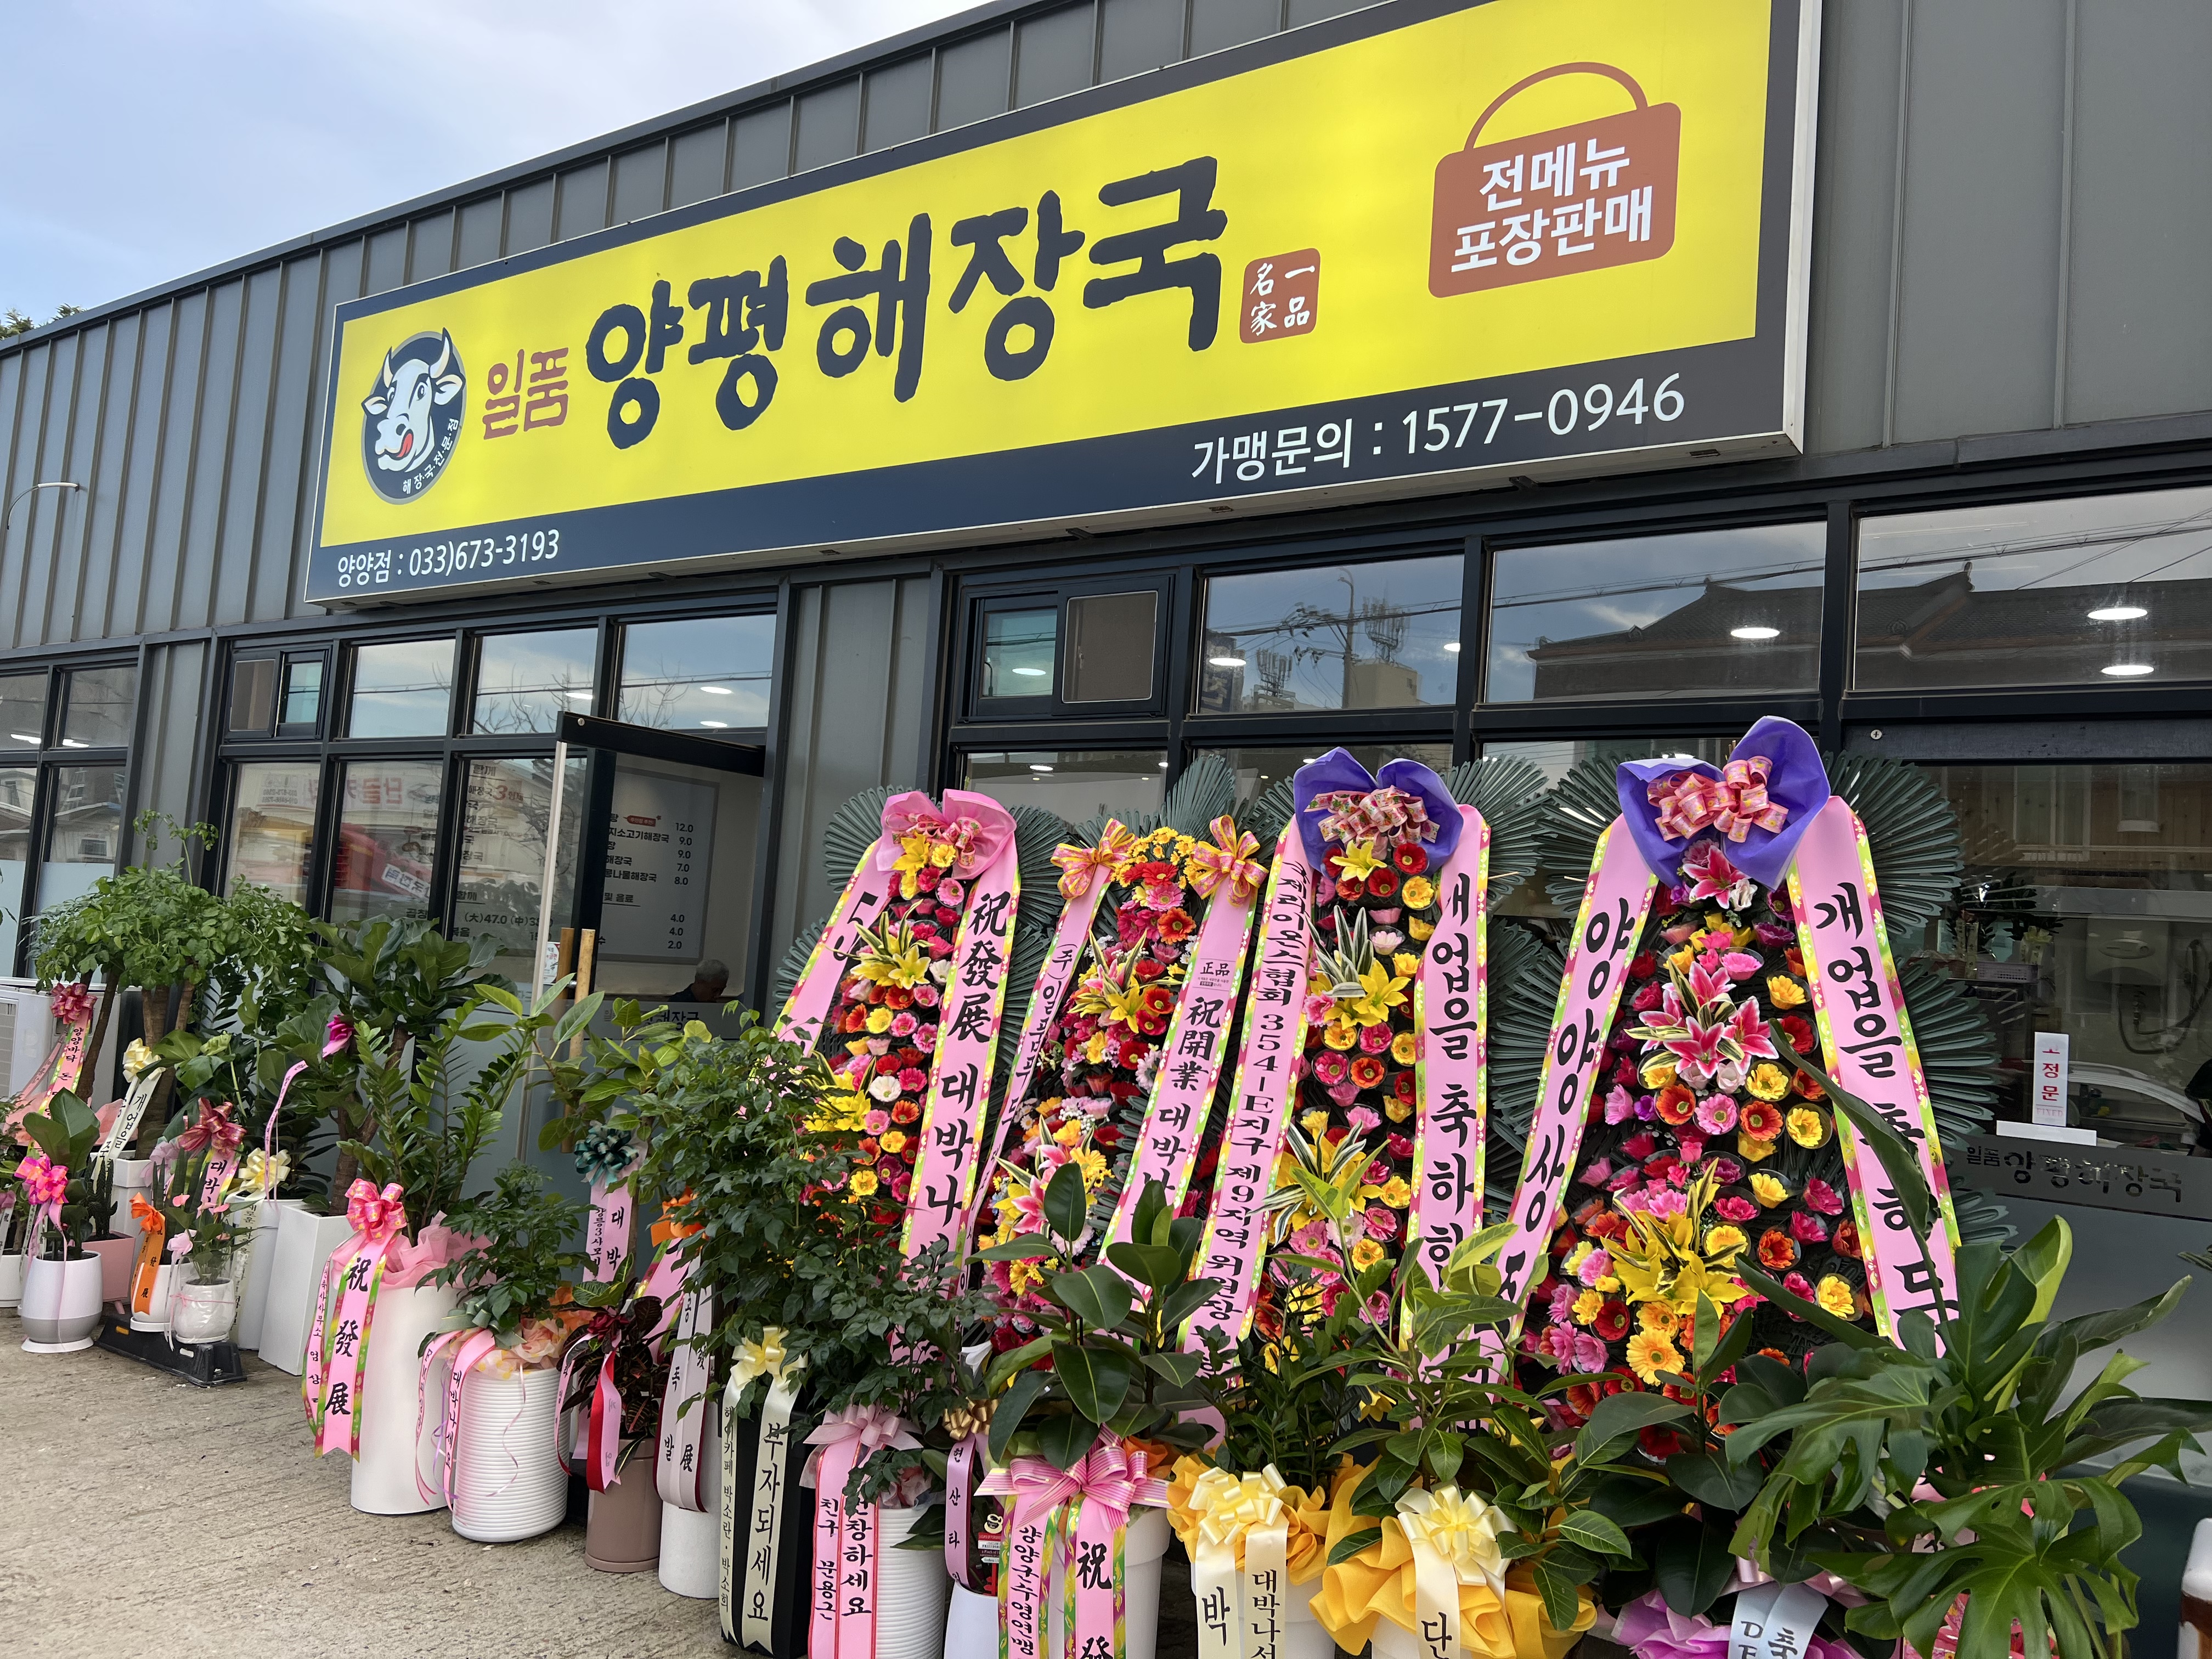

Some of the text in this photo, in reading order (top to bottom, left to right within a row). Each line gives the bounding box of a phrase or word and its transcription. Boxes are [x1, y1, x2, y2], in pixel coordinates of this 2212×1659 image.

[1479, 137, 1630, 212] 전메뉴
[1450, 185, 1653, 274] 포장판매
[483, 156, 1228, 450] 일품 양평해장국
[1190, 417, 1353, 485] 가맹문의
[1402, 372, 1685, 454] 1577-0946
[337, 549, 391, 588] 양양점
[408, 528, 560, 578] 033)673-3193
[675, 823, 694, 833] 12.0
[679, 837, 692, 846] 9.0
[676, 864, 690, 872] 7.0
[678, 850, 691, 859] 9.0
[674, 877, 689, 885] 8.0
[669, 927, 684, 936] 4.0
[670, 914, 685, 923] 4.0
[668, 940, 682, 950] 2.0
[947, 890, 1011, 1043] 祝發展
[1200, 962, 1230, 977] 正品
[1814, 882, 1903, 1079] 개업을
[1170, 996, 1224, 1091] 祝開業
[204, 1159, 228, 1205] 대박
[324, 1256, 372, 1415] 祝發展
[747, 1421, 784, 1622] 부자되세요
[817, 1498, 839, 1538] 친구
